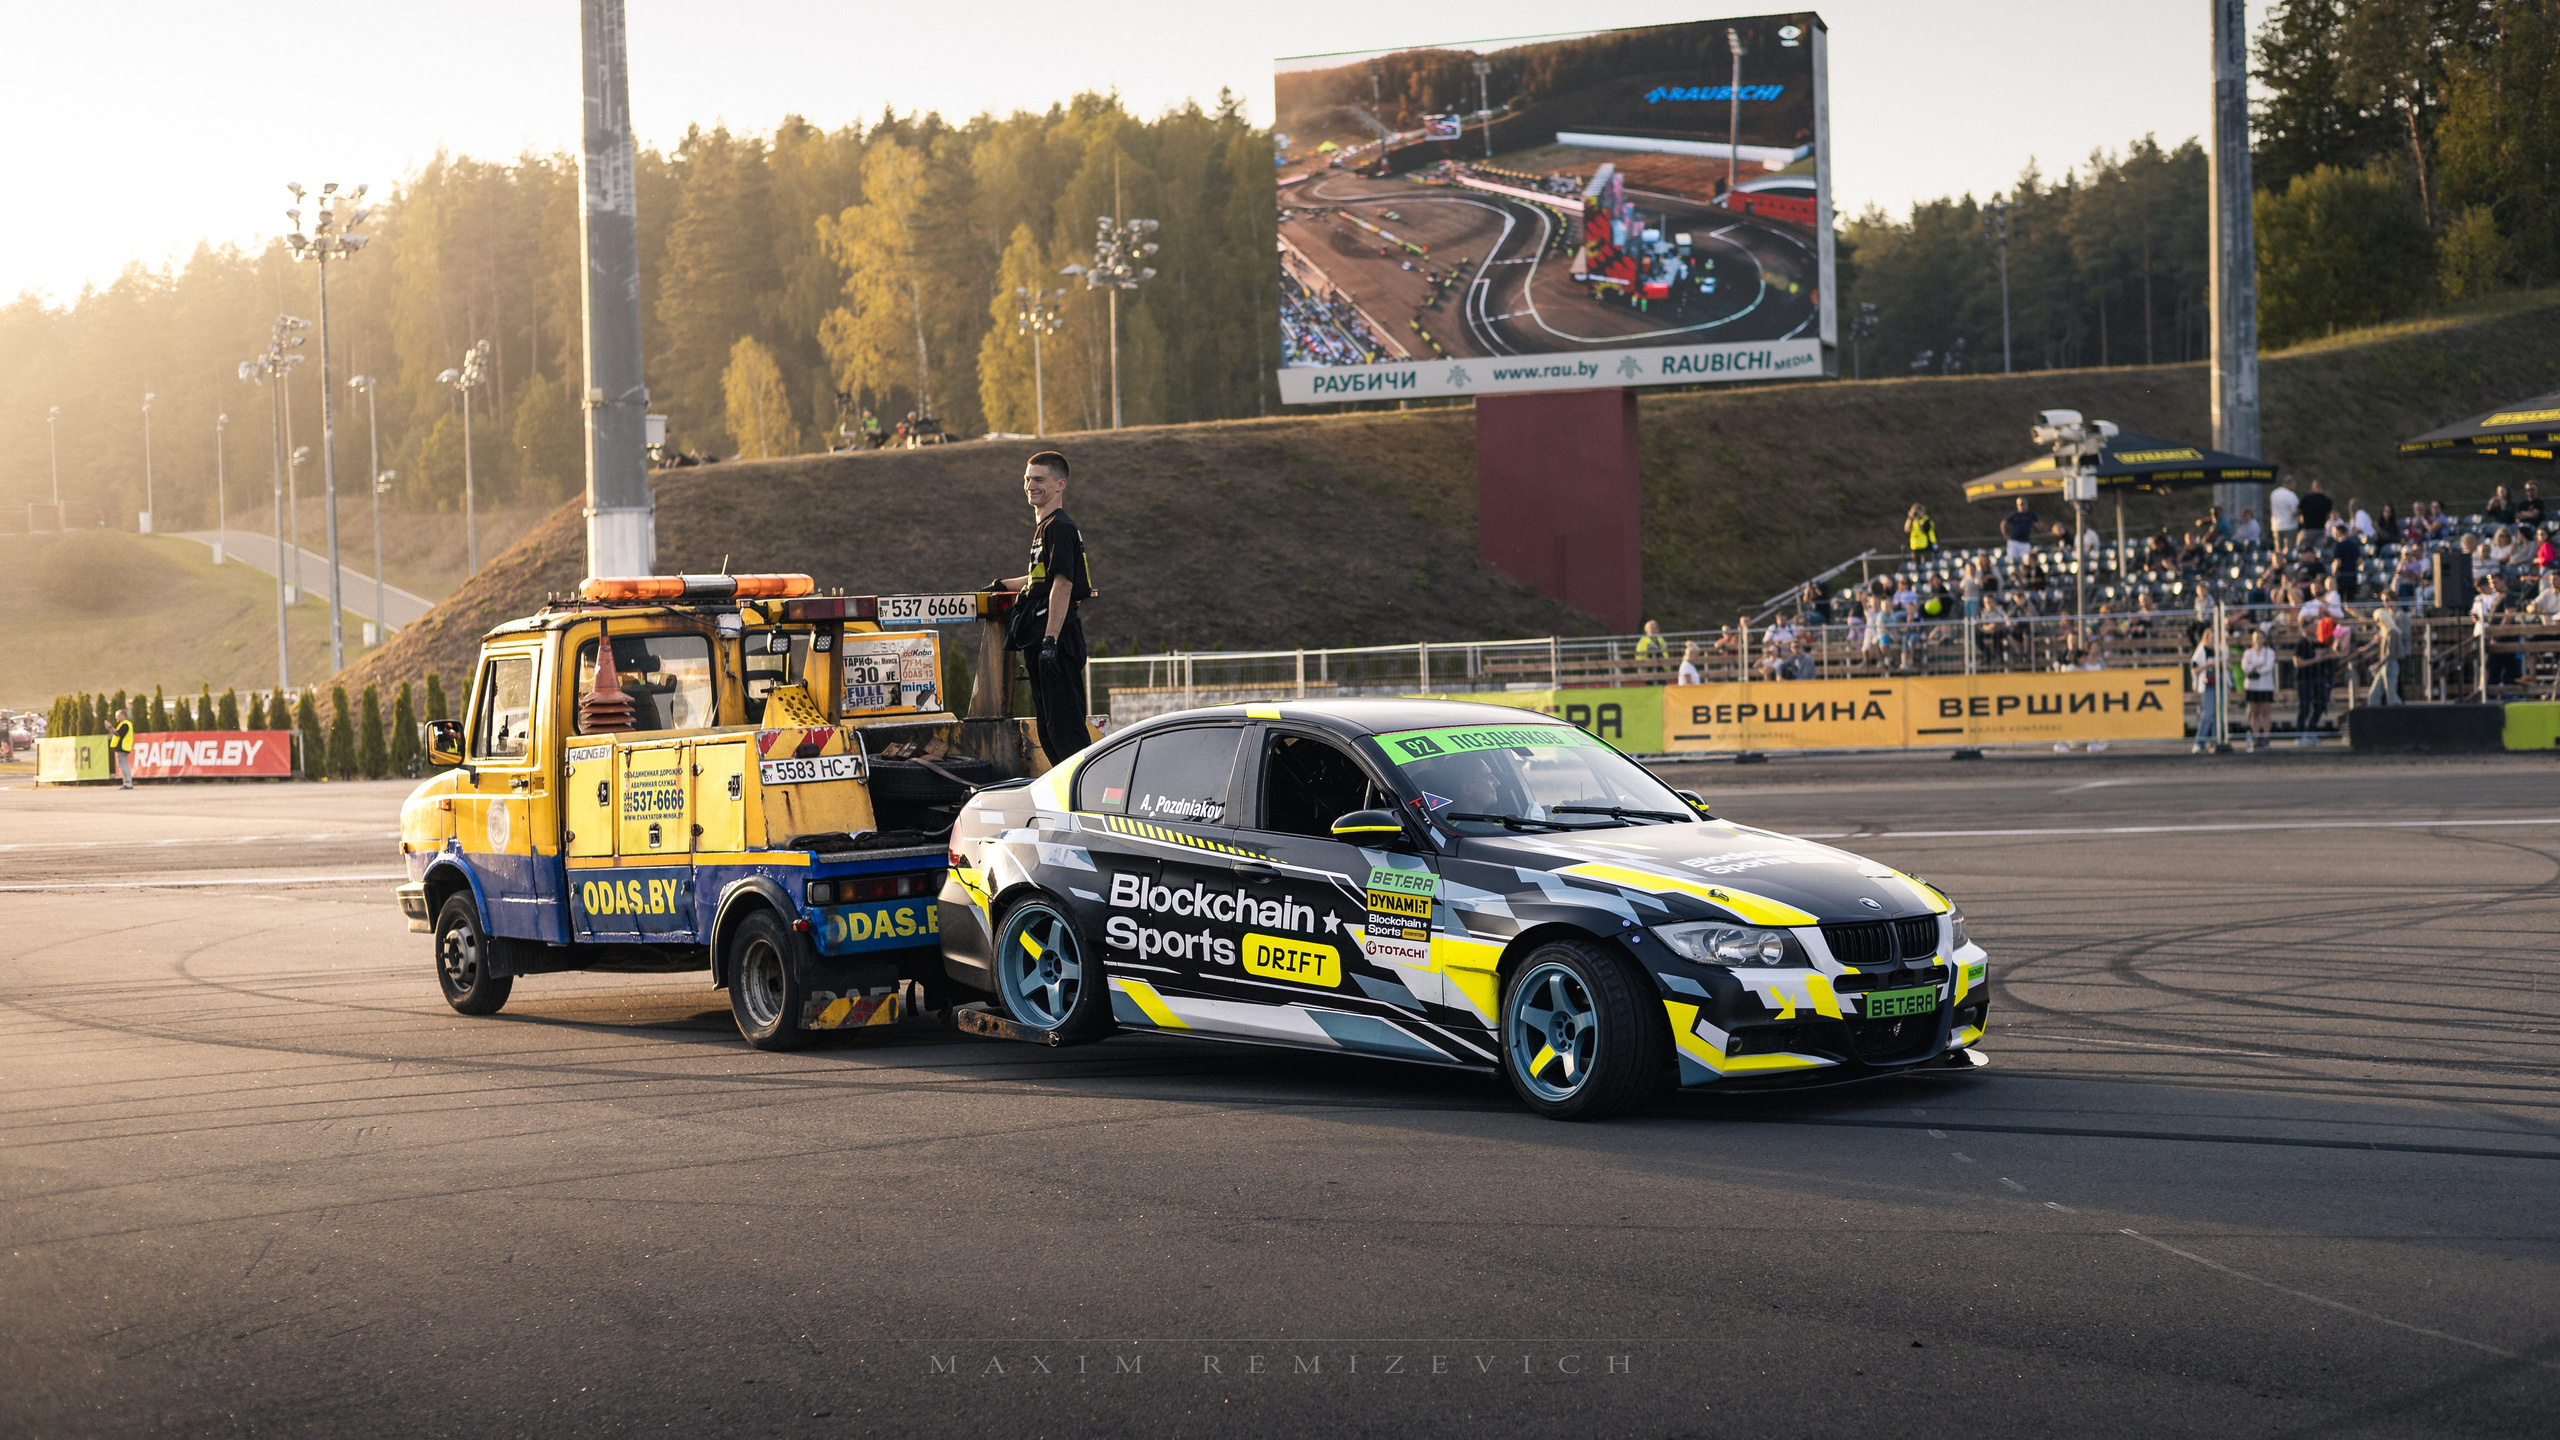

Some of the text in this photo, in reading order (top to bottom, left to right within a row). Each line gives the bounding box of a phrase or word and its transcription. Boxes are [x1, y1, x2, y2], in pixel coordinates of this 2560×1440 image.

[1666, 84, 1785, 101] RAUBCHI
[1493, 360, 1598, 381] www.rau.by
[1661, 350, 1814, 374] RAUBICHI MEDIA
[1313, 371, 1416, 394] РАУБИЧИ
[892, 599, 922, 618] 537
[928, 597, 968, 616] 6666
[844, 656, 873, 668] ТАРИФ
[854, 666, 879, 684] 30
[902, 669, 934, 679] ODAS 13
[847, 685, 884, 698] FULL
[901, 681, 936, 692] minsk
[848, 695, 884, 708] SPEED
[1408, 739, 1436, 755] 92
[1447, 730, 1564, 750] ПОЗДНЯКОВ
[134, 739, 263, 768] RACING.BY
[571, 746, 611, 762] RACING.BY
[776, 760, 816, 780] 5583
[658, 778, 677, 787] СЛУЖБА
[624, 791, 633, 801] 044
[633, 788, 684, 812] 537-6666
[624, 803, 633, 812] 029
[1140, 794, 1222, 819] A. Pozdniakov
[583, 879, 677, 916] ODAS.BY
[1110, 871, 1315, 934] Blockchain
[1368, 924, 1402, 936] Sports
[1369, 914, 1421, 929] Blockchain
[1105, 915, 1236, 966] Sports
[1256, 944, 1327, 977] DRIFT
[1378, 944, 1425, 959] TOTACHI
